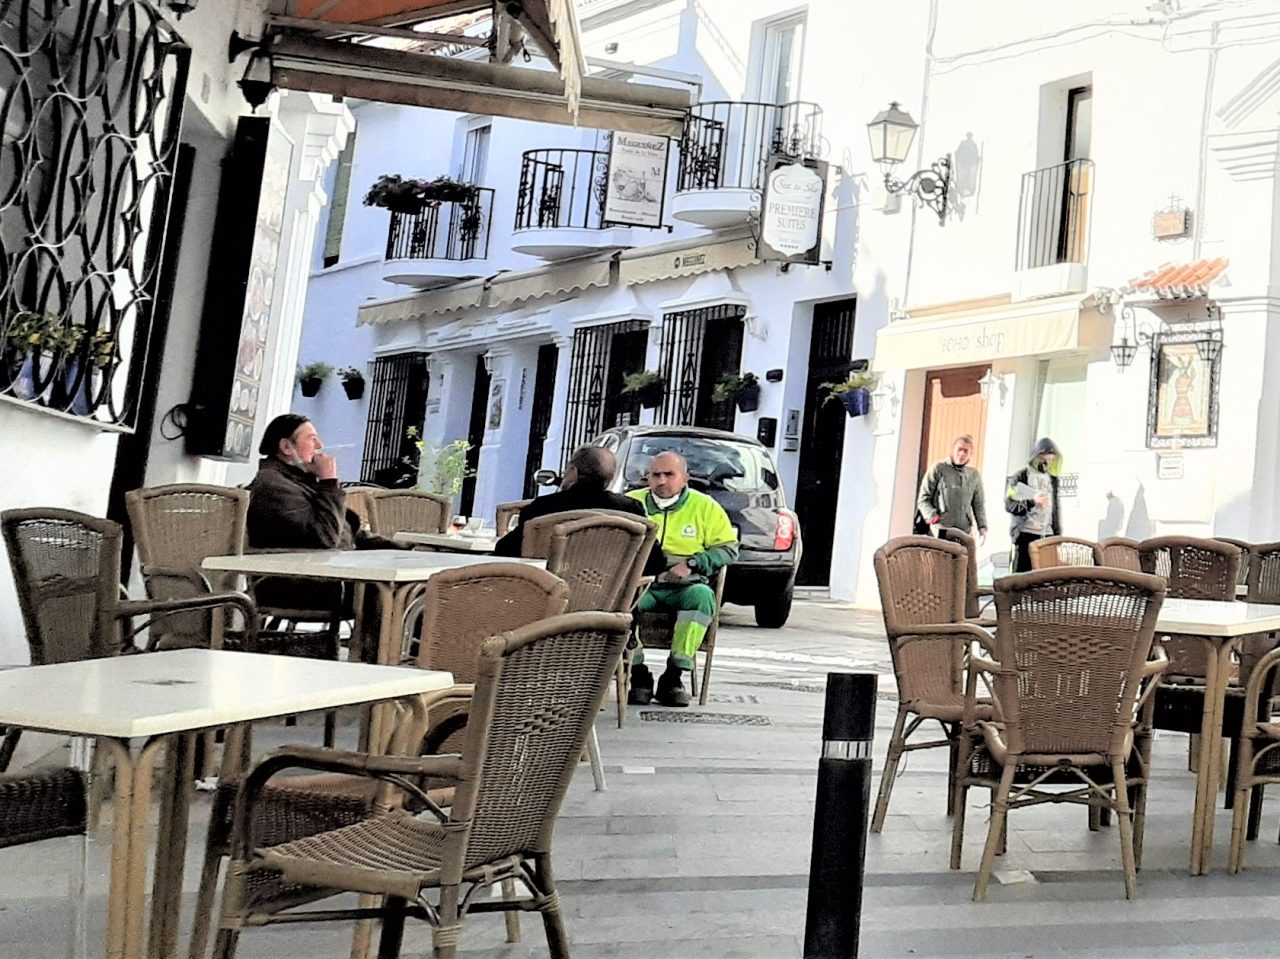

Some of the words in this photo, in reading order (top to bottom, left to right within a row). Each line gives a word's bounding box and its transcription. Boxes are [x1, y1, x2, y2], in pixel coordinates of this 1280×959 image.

[768, 201, 818, 219] PREMIERE
[776, 216, 807, 231] SUITES
[976, 325, 1006, 354] shop
